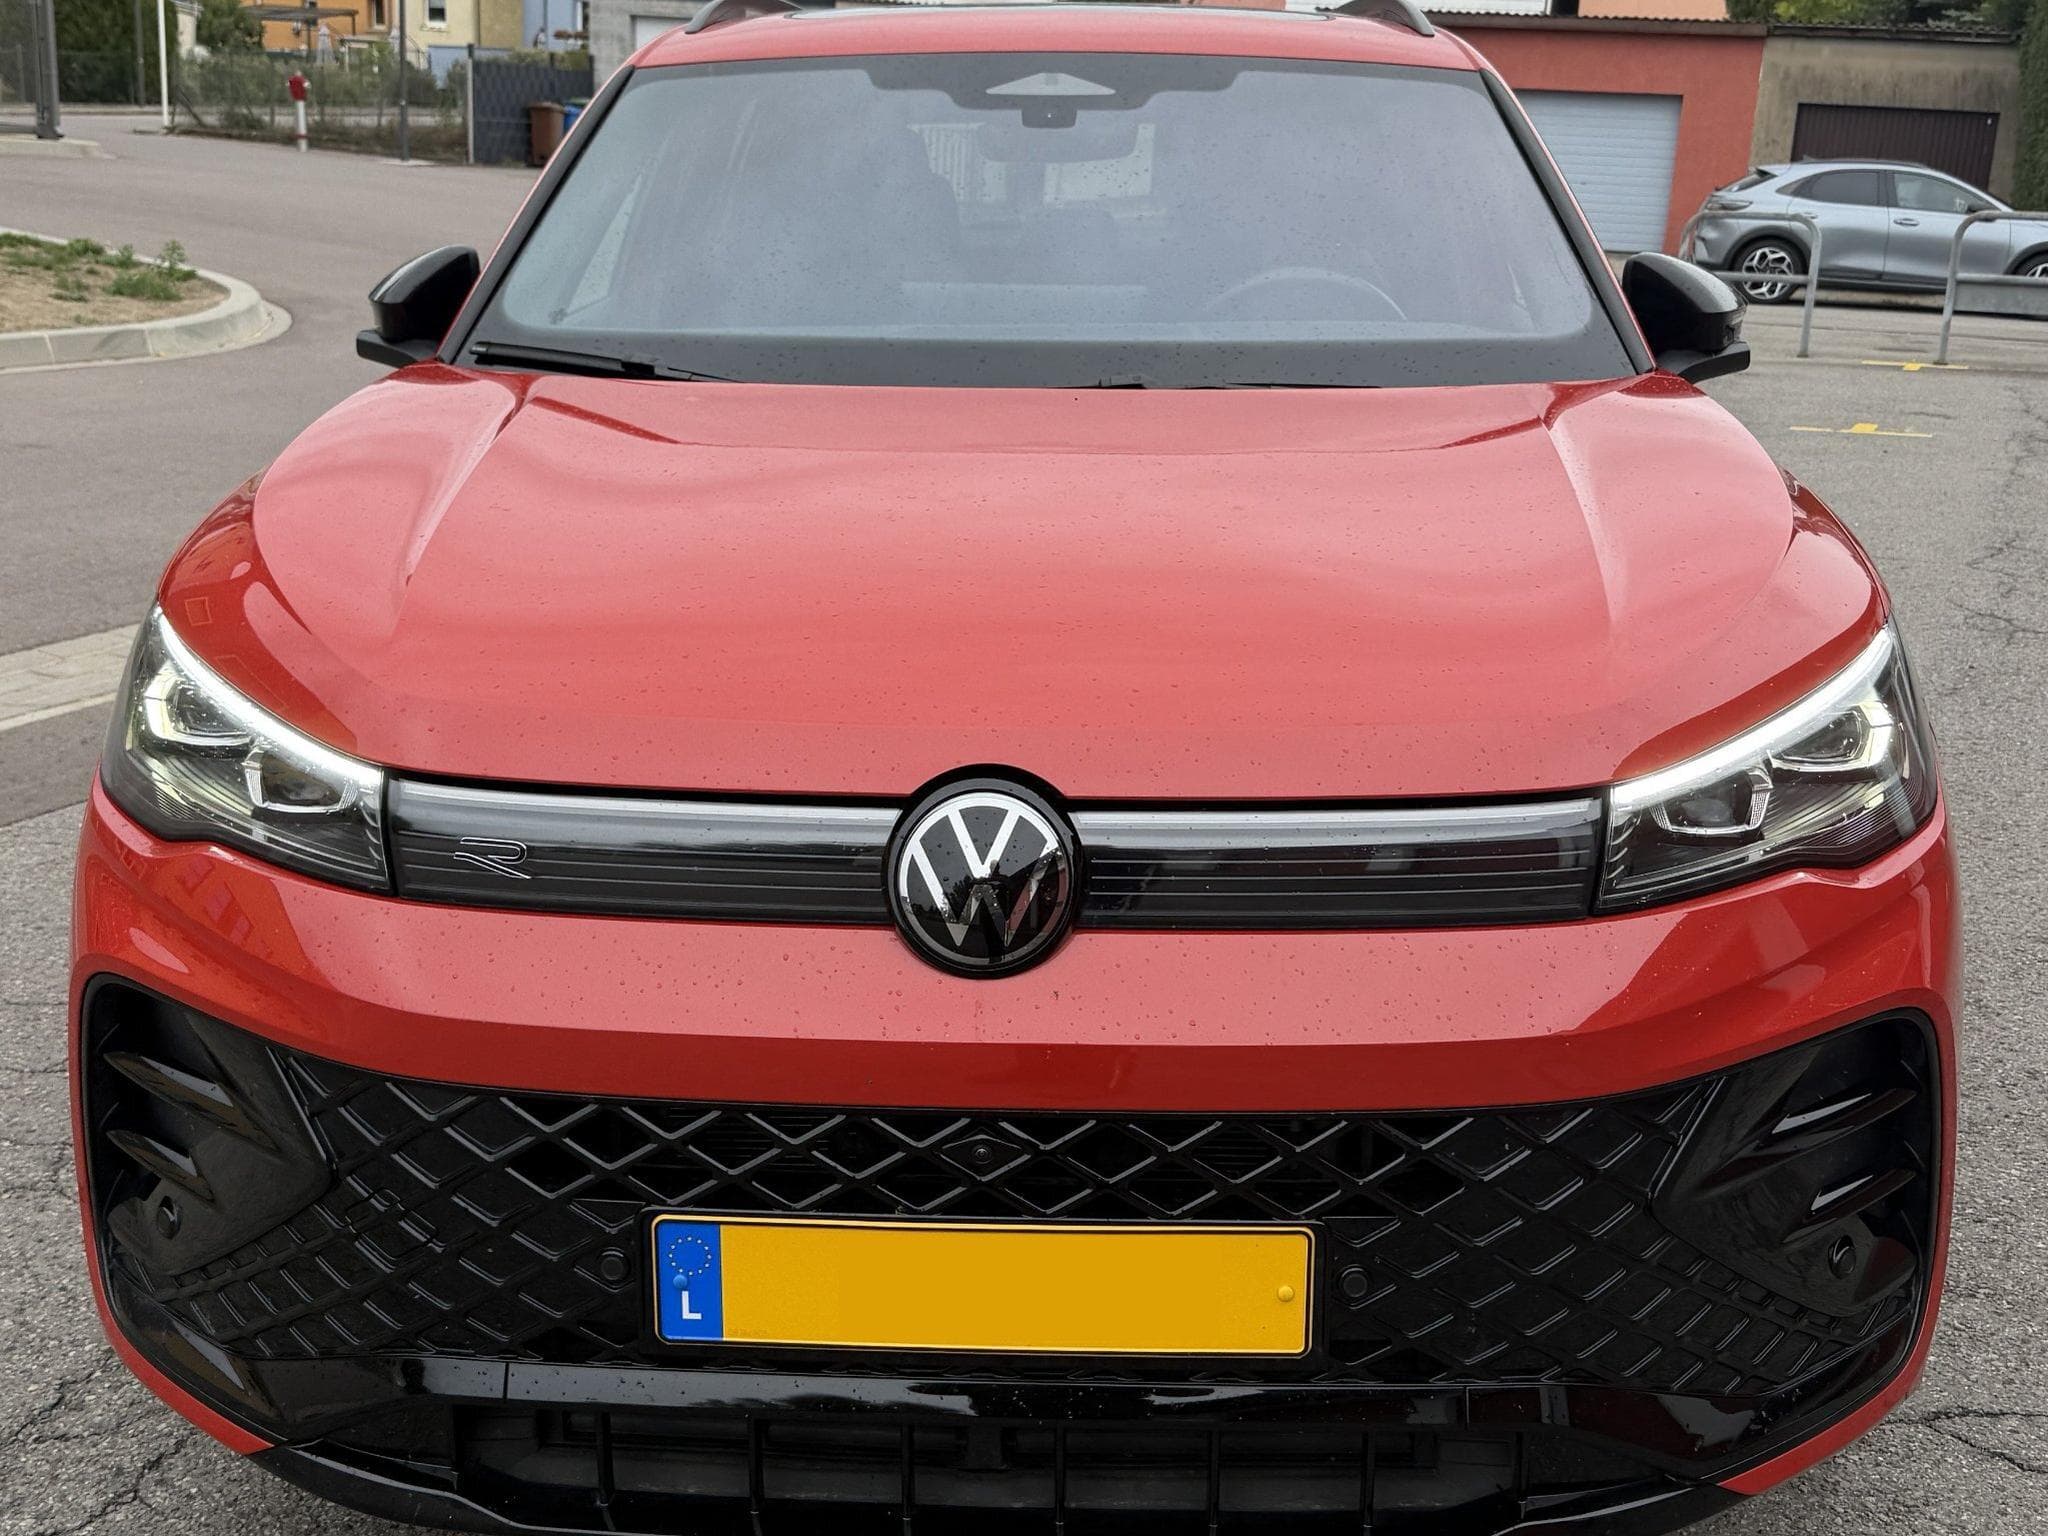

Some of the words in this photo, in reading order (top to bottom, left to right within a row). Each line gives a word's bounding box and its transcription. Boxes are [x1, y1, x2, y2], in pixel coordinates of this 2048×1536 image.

[453, 836, 531, 880] R
[901, 796, 1066, 950] VW
[681, 1290, 702, 1320] L
